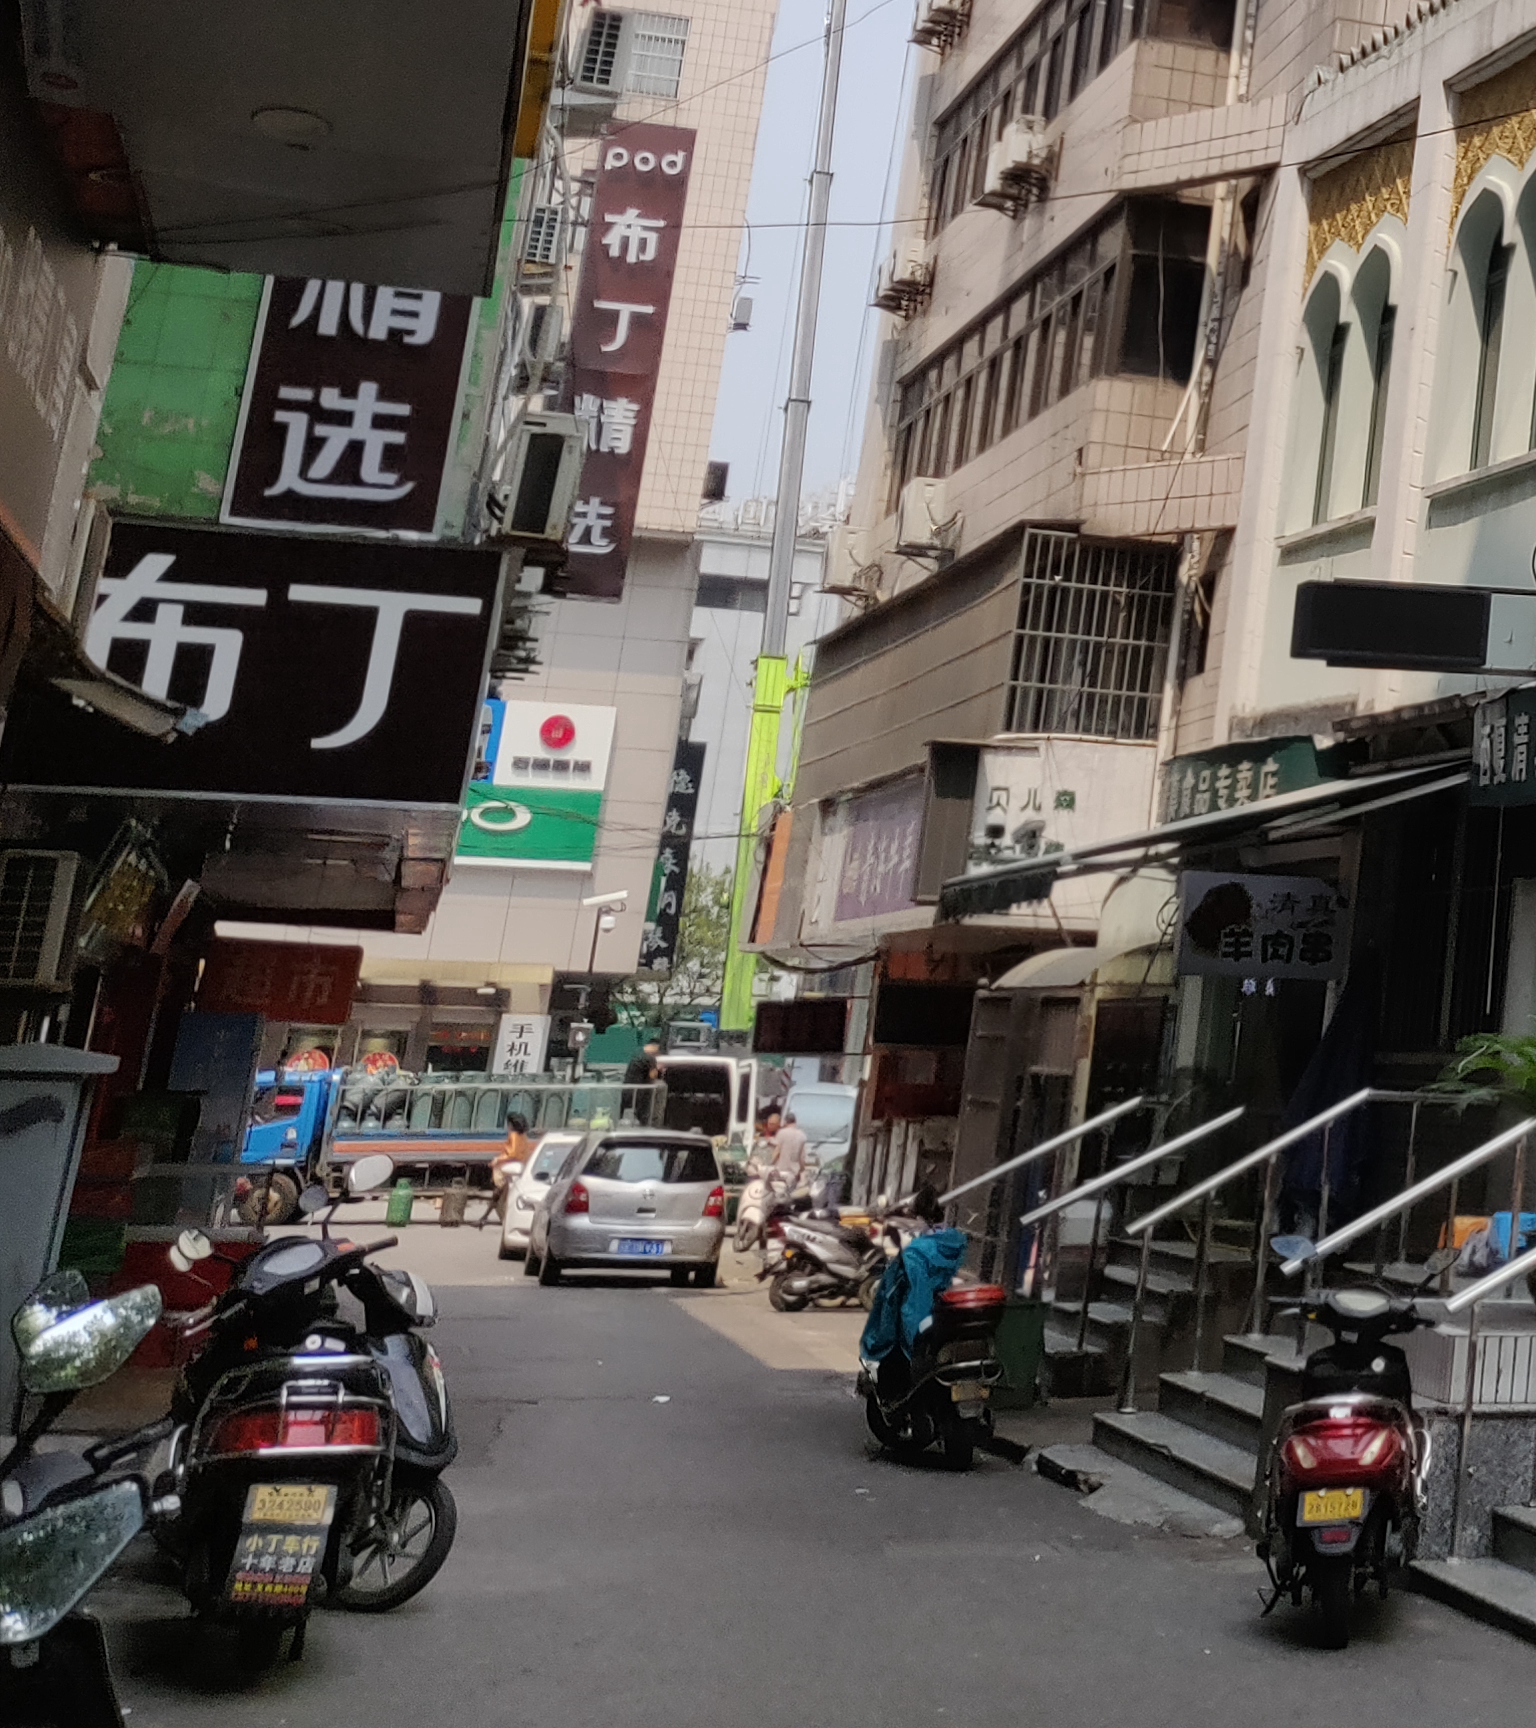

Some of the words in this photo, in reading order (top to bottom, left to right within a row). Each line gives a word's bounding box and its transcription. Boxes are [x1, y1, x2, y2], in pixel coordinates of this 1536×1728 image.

[604, 145, 687, 175] pod
[84, 552, 484, 750] 布丁
[1220, 924, 1334, 966] 羊肉串
